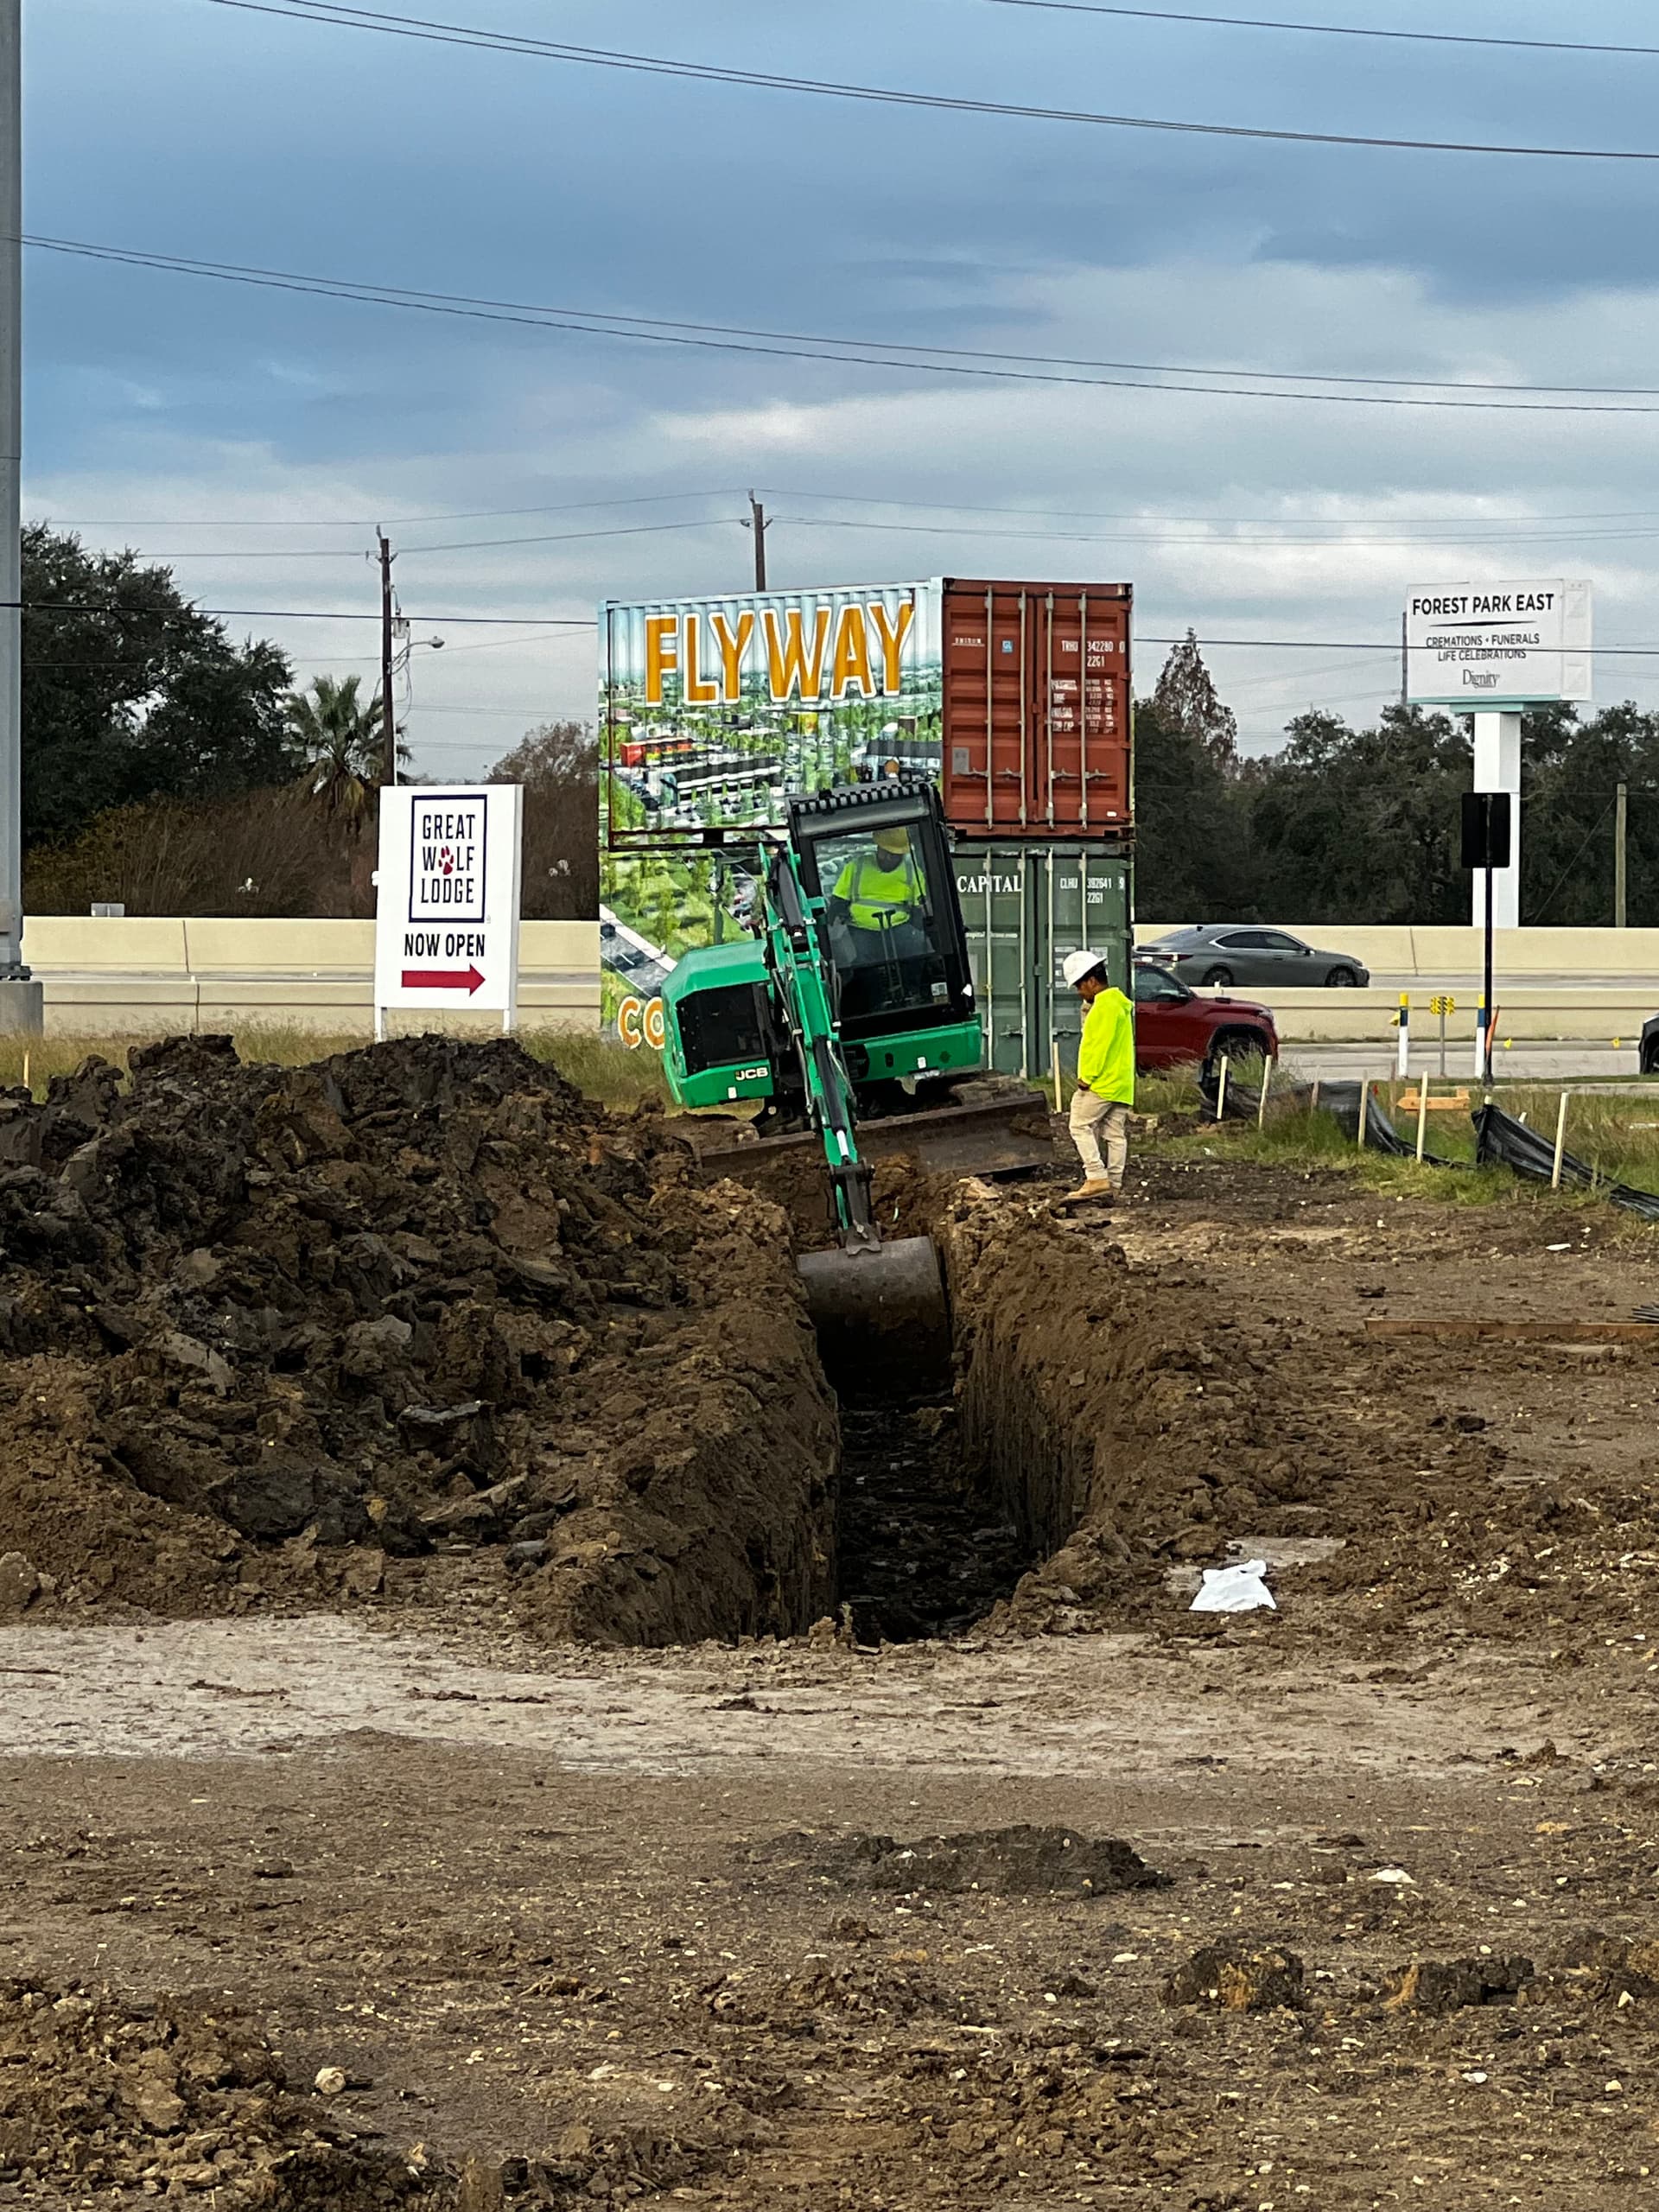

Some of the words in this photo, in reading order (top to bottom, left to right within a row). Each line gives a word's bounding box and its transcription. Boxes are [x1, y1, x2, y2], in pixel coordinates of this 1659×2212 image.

[1413, 597, 1468, 615] FOREST
[1472, 595, 1512, 613] PARK
[1516, 593, 1554, 611] EAST
[1426, 635, 1483, 648] CREMATIONS
[1491, 632, 1540, 645] FUNERALS
[645, 600, 914, 707] FLYWAY
[1438, 649, 1456, 662] LIFE
[1459, 648, 1527, 662] CELEBRATIONS
[1462, 669, 1498, 689] Dignity
[423, 814, 475, 839] GREAT
[421, 878, 474, 903] LODGE
[957, 875, 1024, 893] CAPITAL
[404, 934, 440, 957] NOW
[446, 934, 485, 957] OPEN
[735, 1067, 768, 1080] JCB
